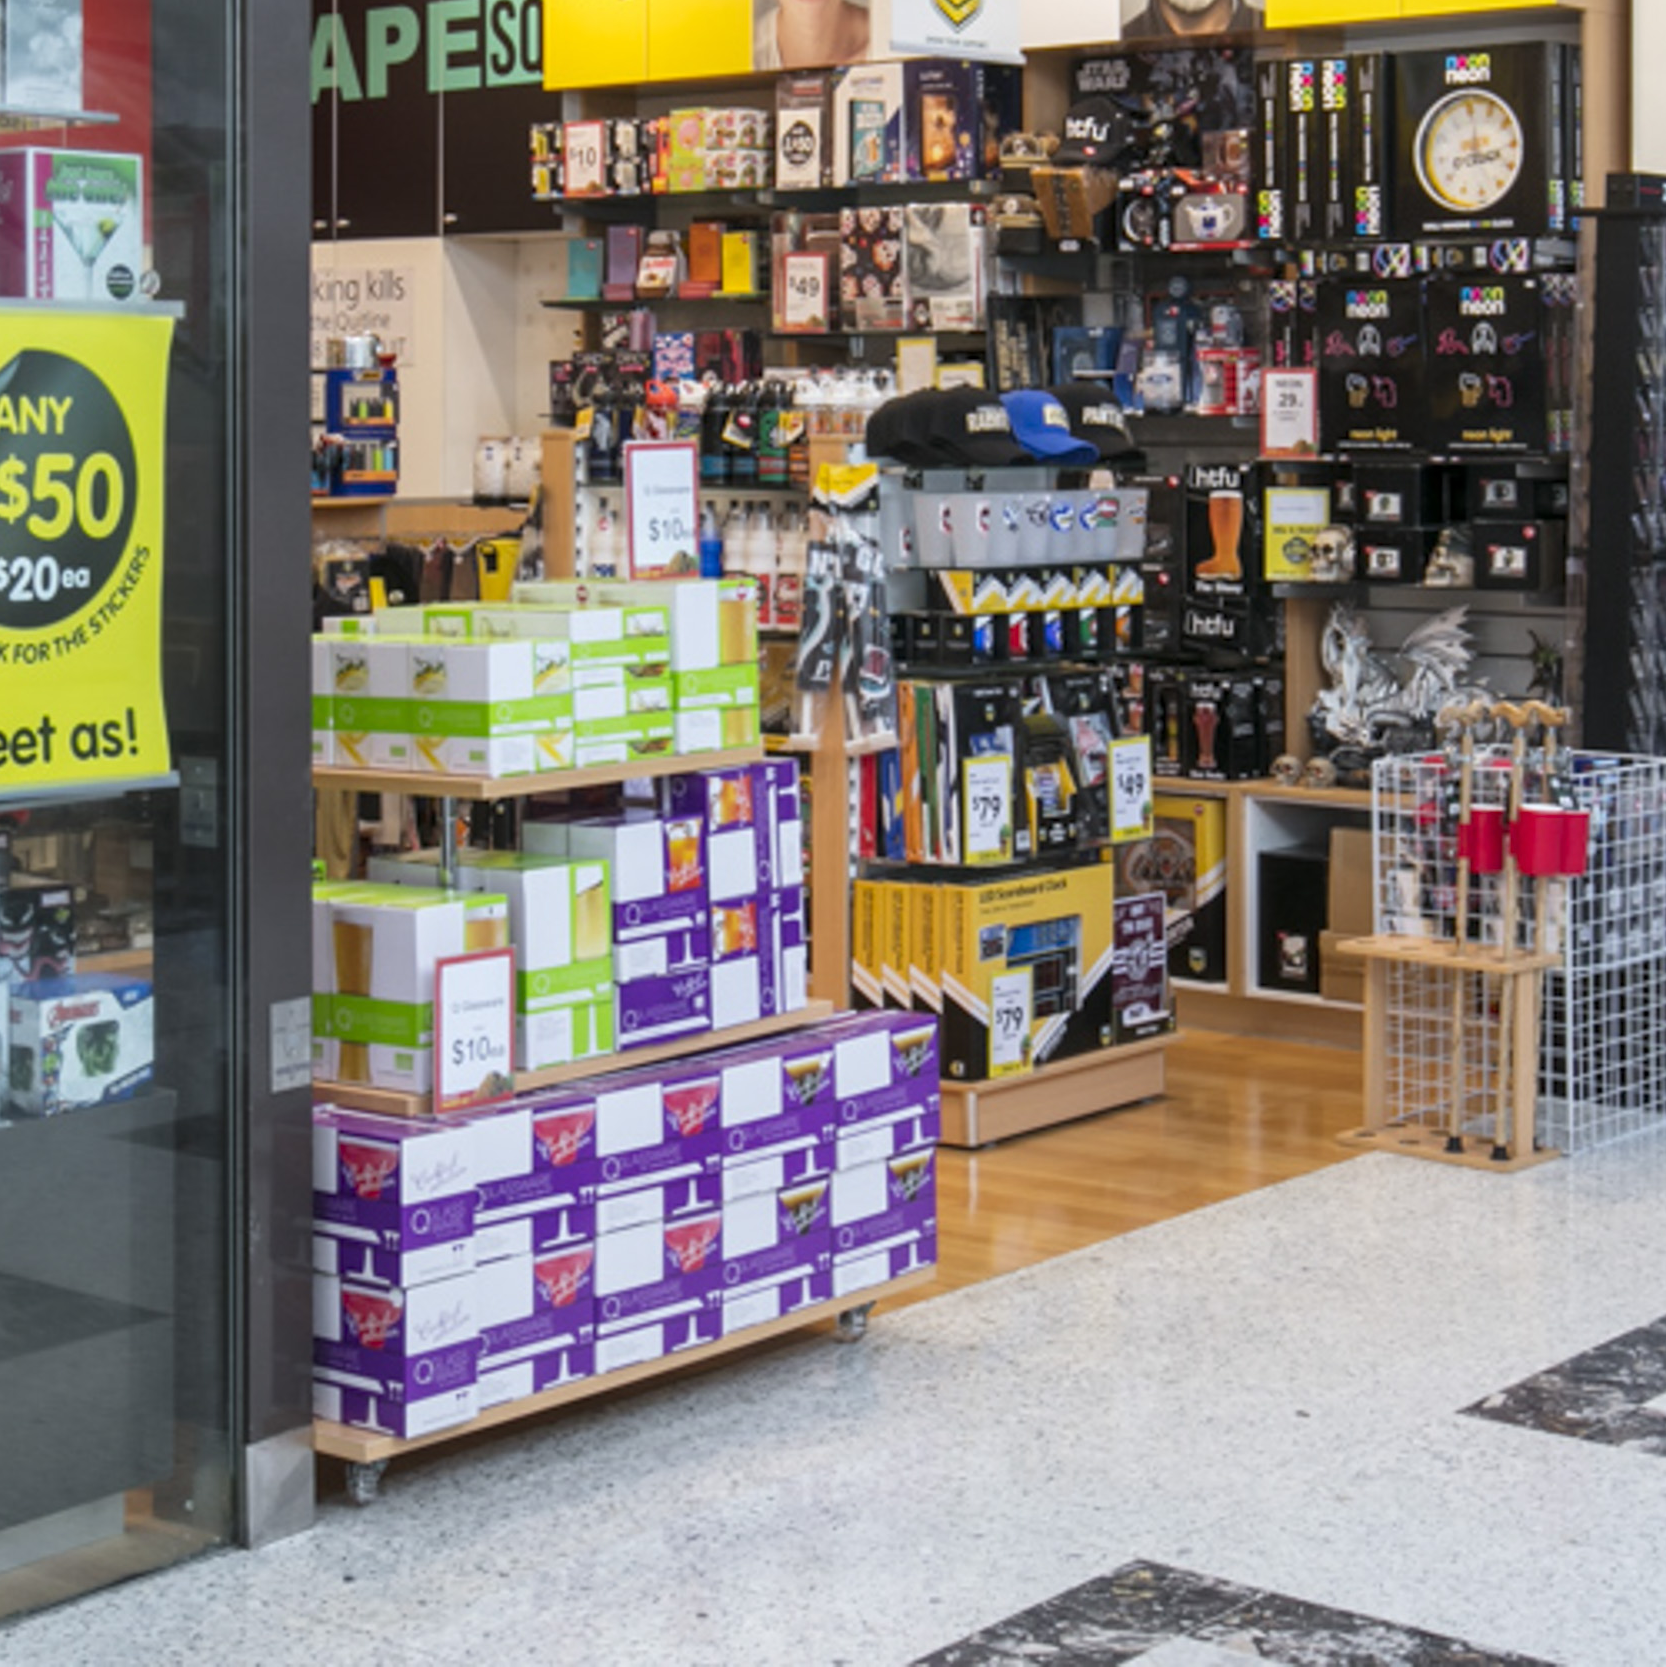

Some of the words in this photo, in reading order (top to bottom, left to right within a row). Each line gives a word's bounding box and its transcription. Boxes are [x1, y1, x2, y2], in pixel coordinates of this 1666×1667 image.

[366, 269, 406, 302] kills
[1345, 302, 1390, 319] neon
[1459, 299, 1506, 315] neon
[61, 566, 92, 590] ea
[12, 642, 50, 665] FOR
[52, 624, 90, 658] THE
[88, 543, 151, 636] STICKERS
[71, 707, 140, 762] as!
